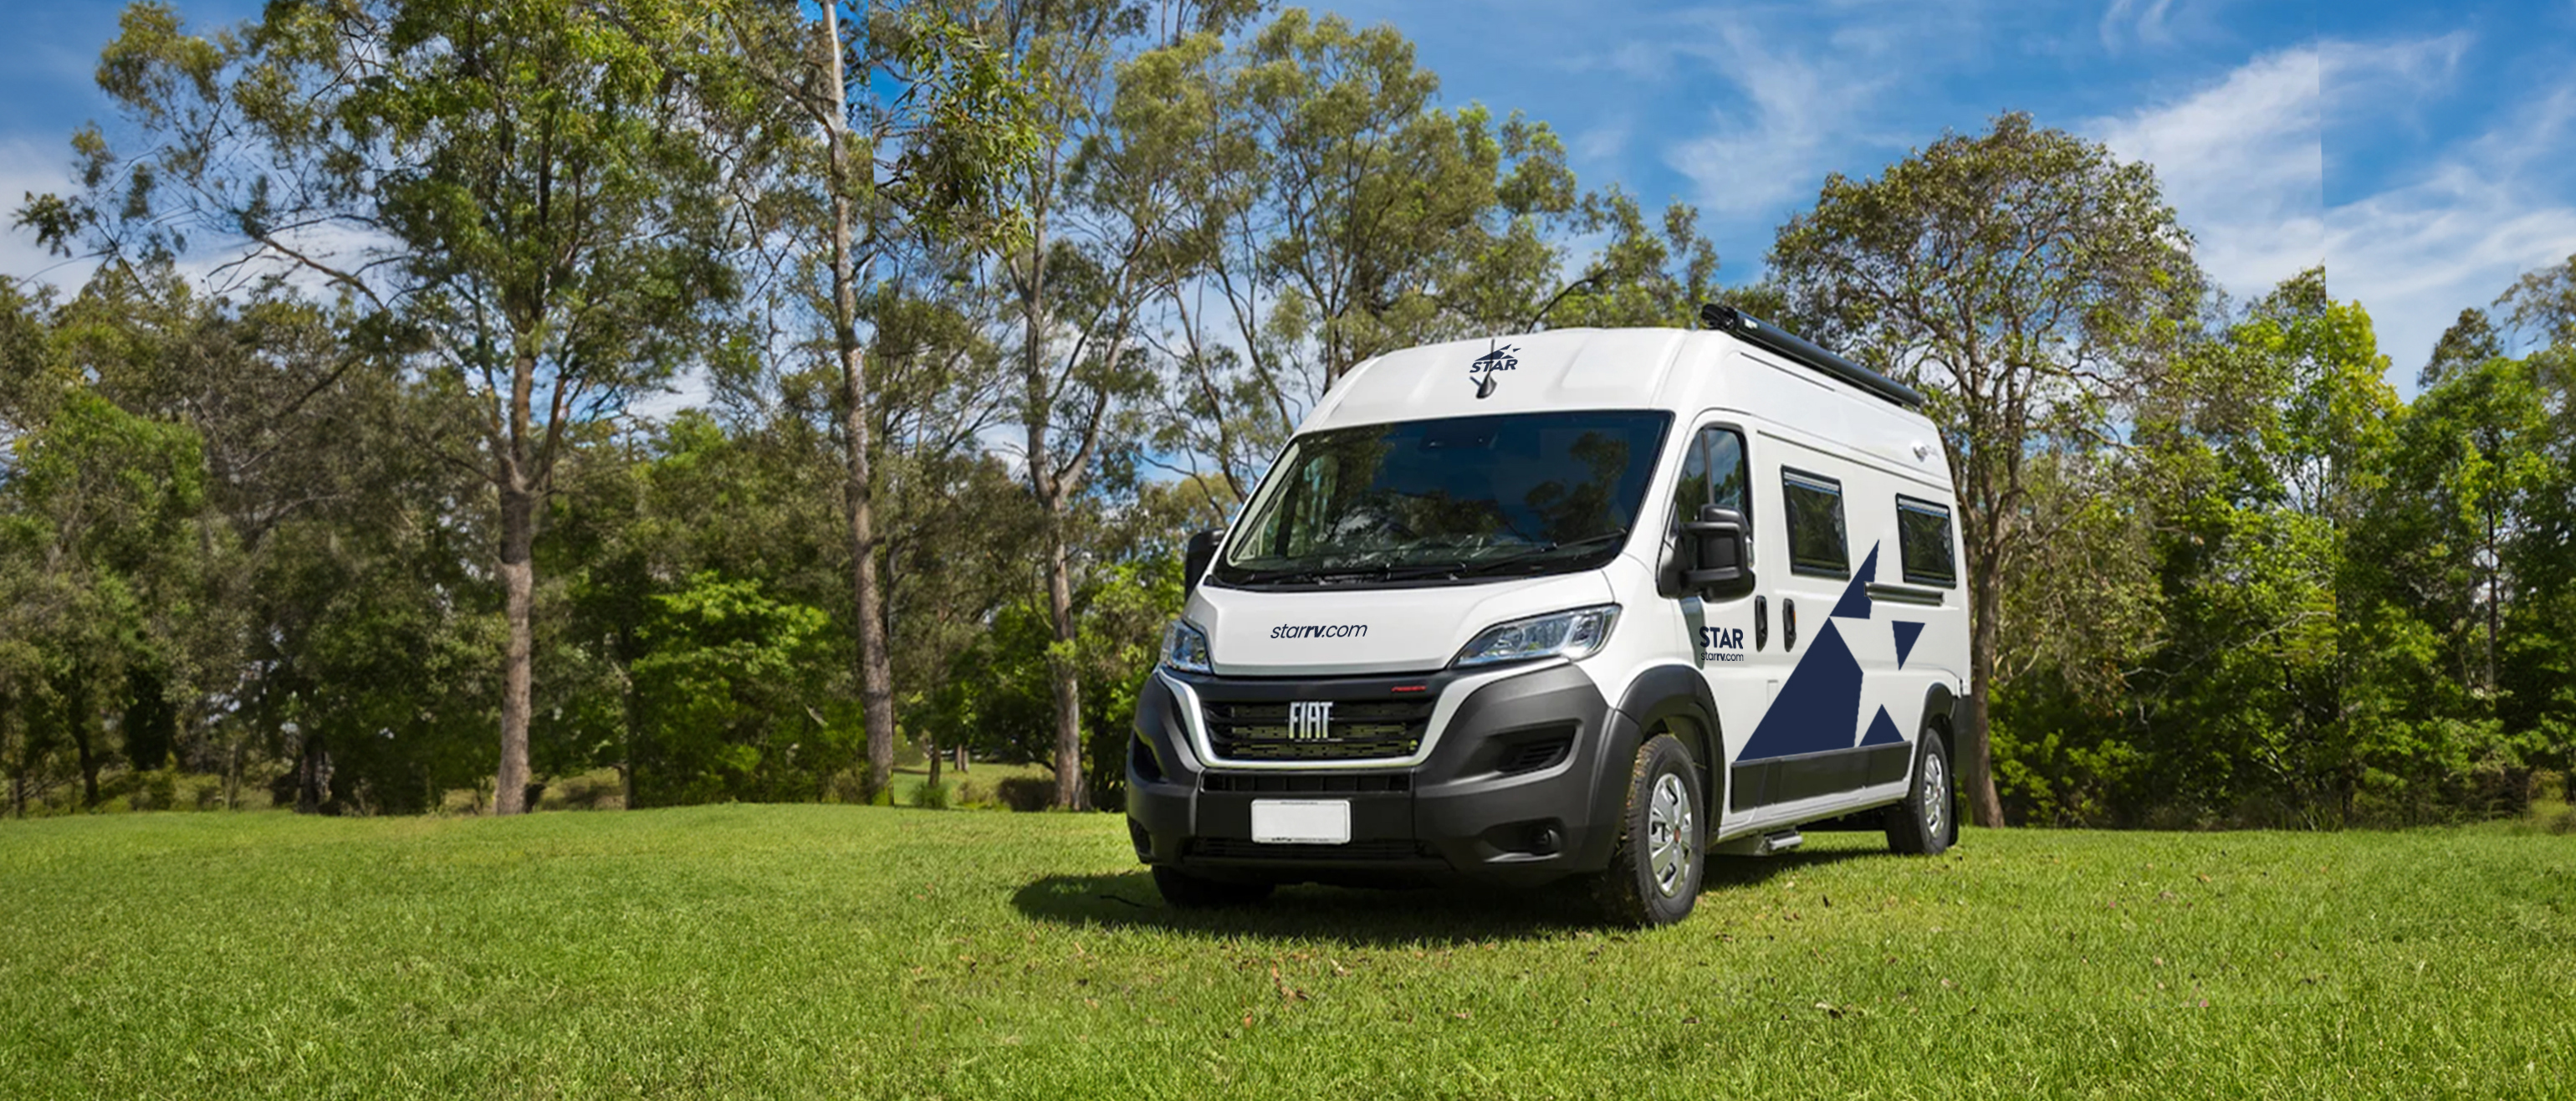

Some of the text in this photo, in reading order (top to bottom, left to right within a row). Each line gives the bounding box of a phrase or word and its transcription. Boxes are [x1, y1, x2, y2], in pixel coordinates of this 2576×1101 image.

[1469, 359, 1518, 373] STAR
[1270, 623, 1367, 638] starrv.com
[1699, 626, 1744, 649] STAR
[1700, 651, 1744, 662] starrv.com
[1289, 701, 1333, 739] FIAT
